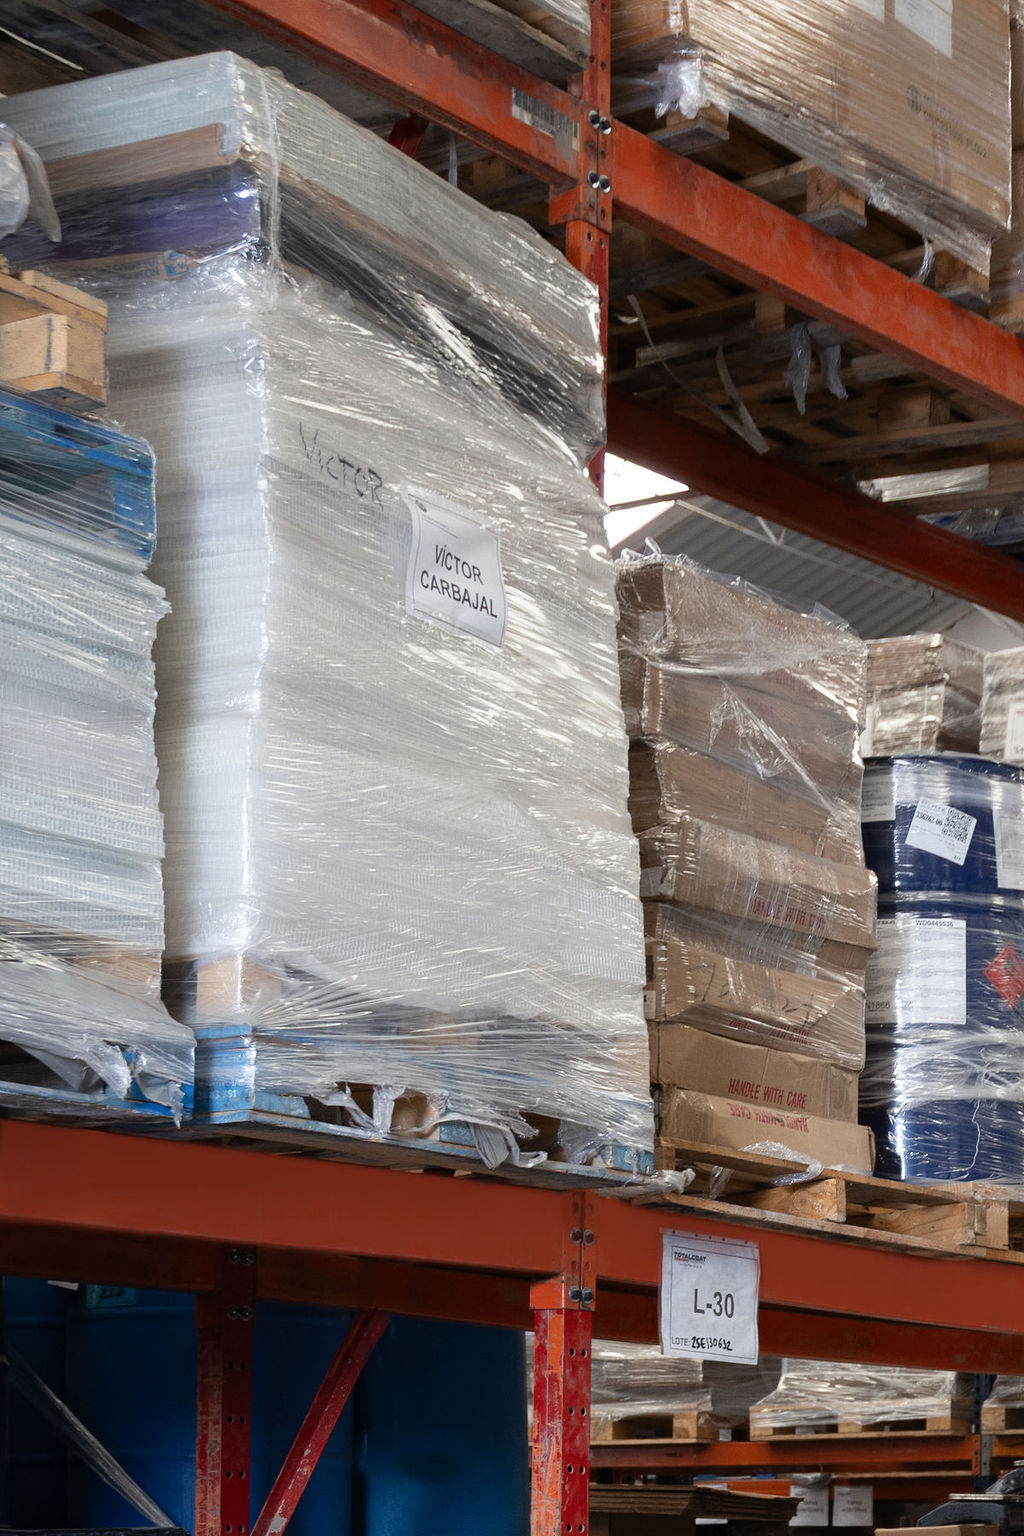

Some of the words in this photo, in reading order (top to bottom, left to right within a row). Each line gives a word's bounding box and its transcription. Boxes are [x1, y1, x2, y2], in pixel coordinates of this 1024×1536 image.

[299, 421, 384, 512] VICTOR
[420, 570, 498, 618] CARBAJAL
[728, 1078, 761, 1100] HANDLE
[763, 1085, 785, 1105] WITH
[786, 1090, 808, 1110] CARE
[674, 1251, 707, 1262] TOTALCOAT
[693, 1287, 735, 1319] L-30
[671, 1336, 691, 1347] LOTE:
